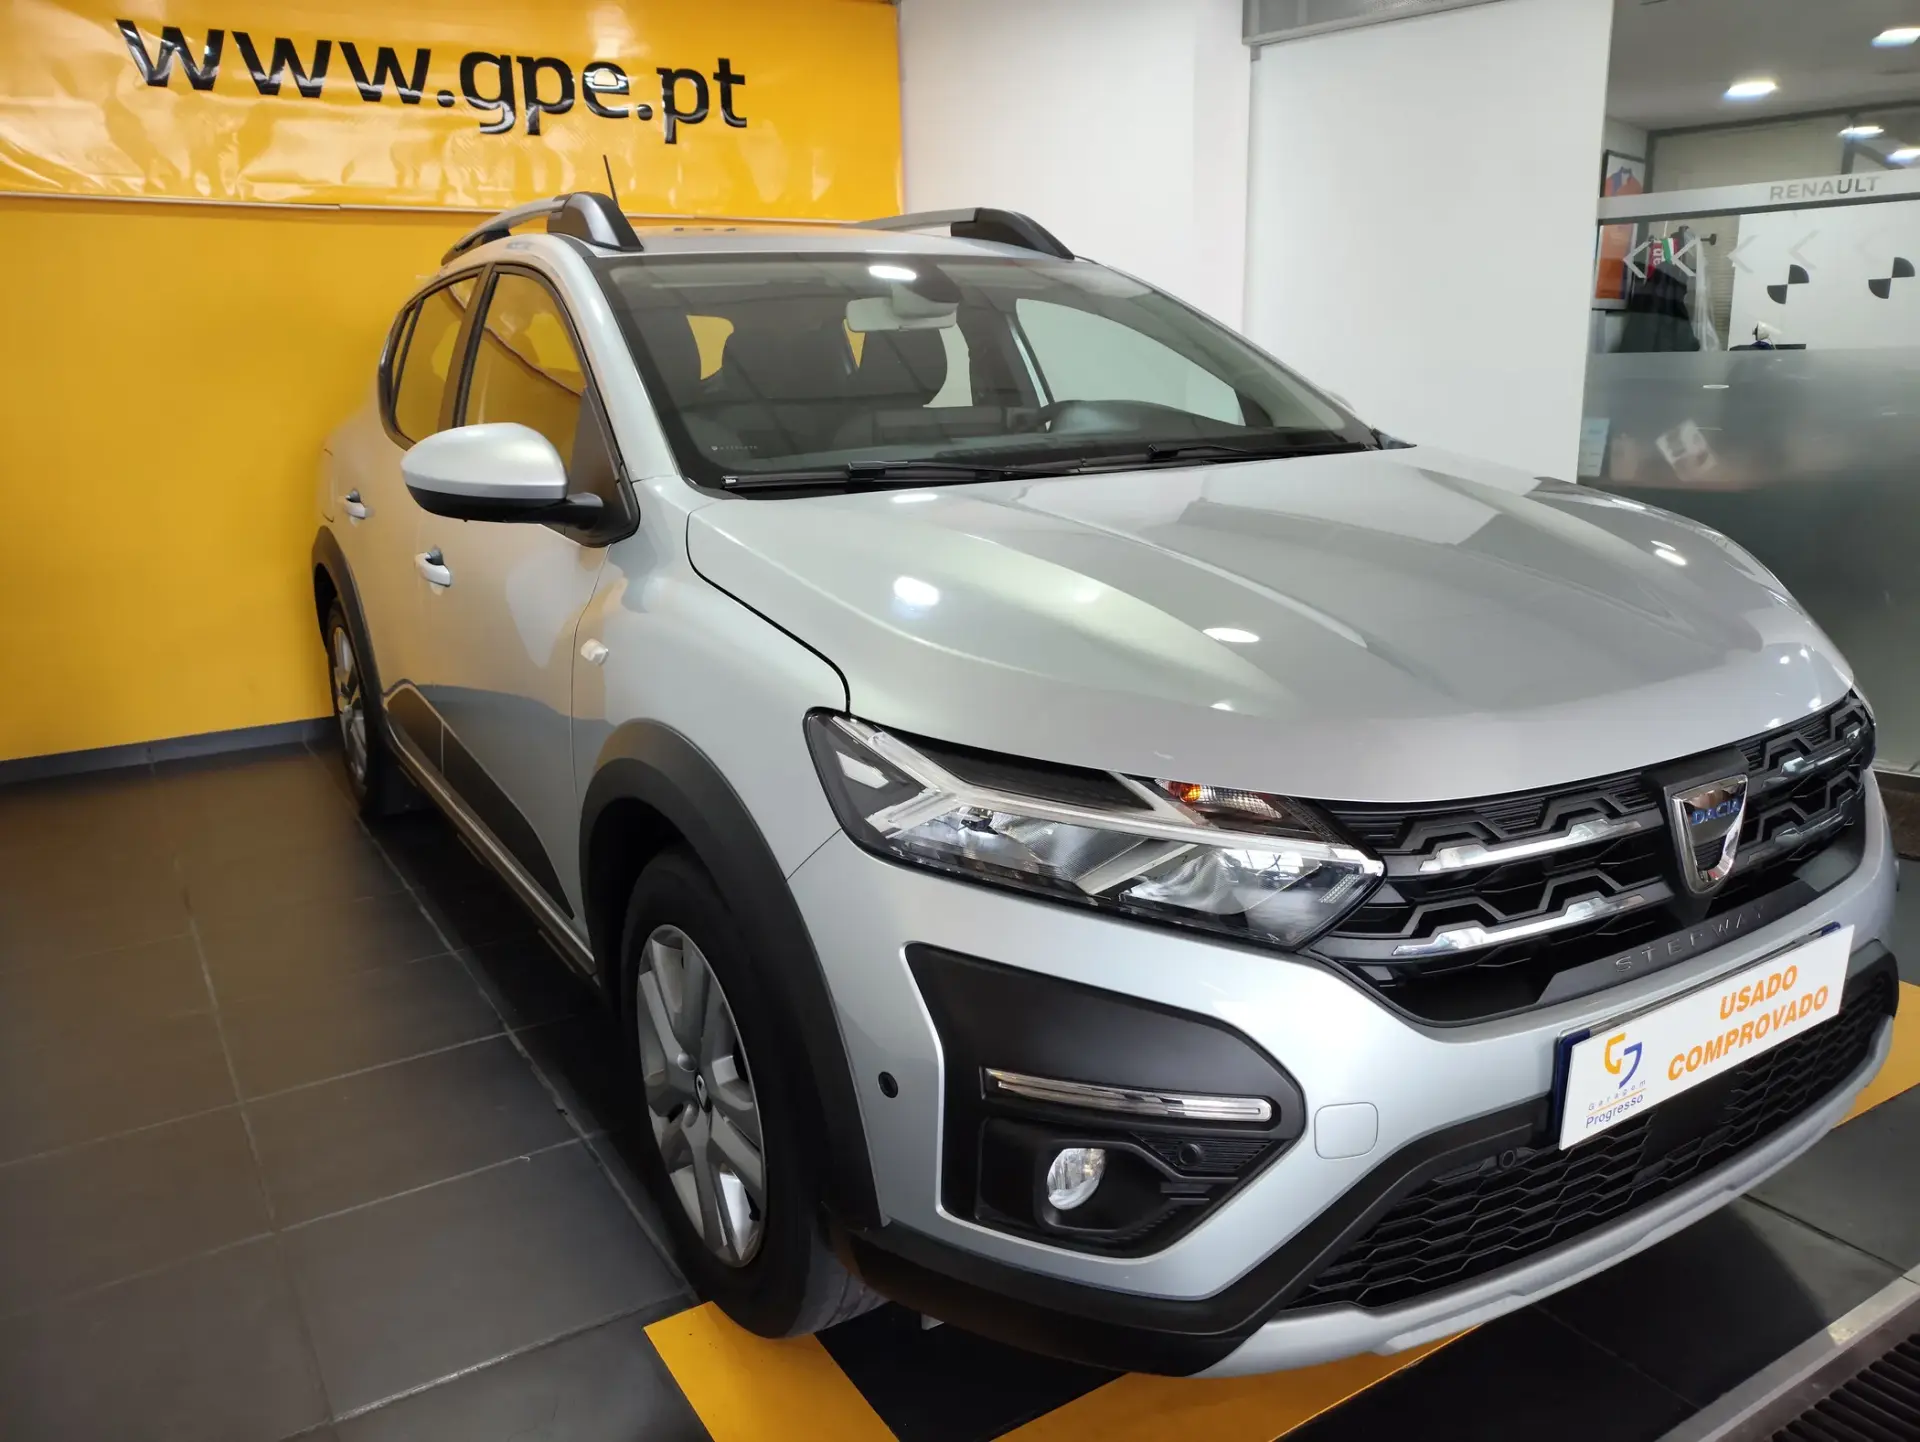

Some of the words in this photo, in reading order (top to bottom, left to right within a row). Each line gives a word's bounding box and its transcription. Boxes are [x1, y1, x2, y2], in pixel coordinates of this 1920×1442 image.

[115, 19, 749, 145] www.gpe.pt
[1769, 176, 1881, 201] RENAULT
[1691, 796, 1742, 827] DACIA
[1719, 964, 1798, 1020] USADO
[1667, 985, 1829, 1081] COMPROVADO
[1585, 1093, 1644, 1129] Progresso
